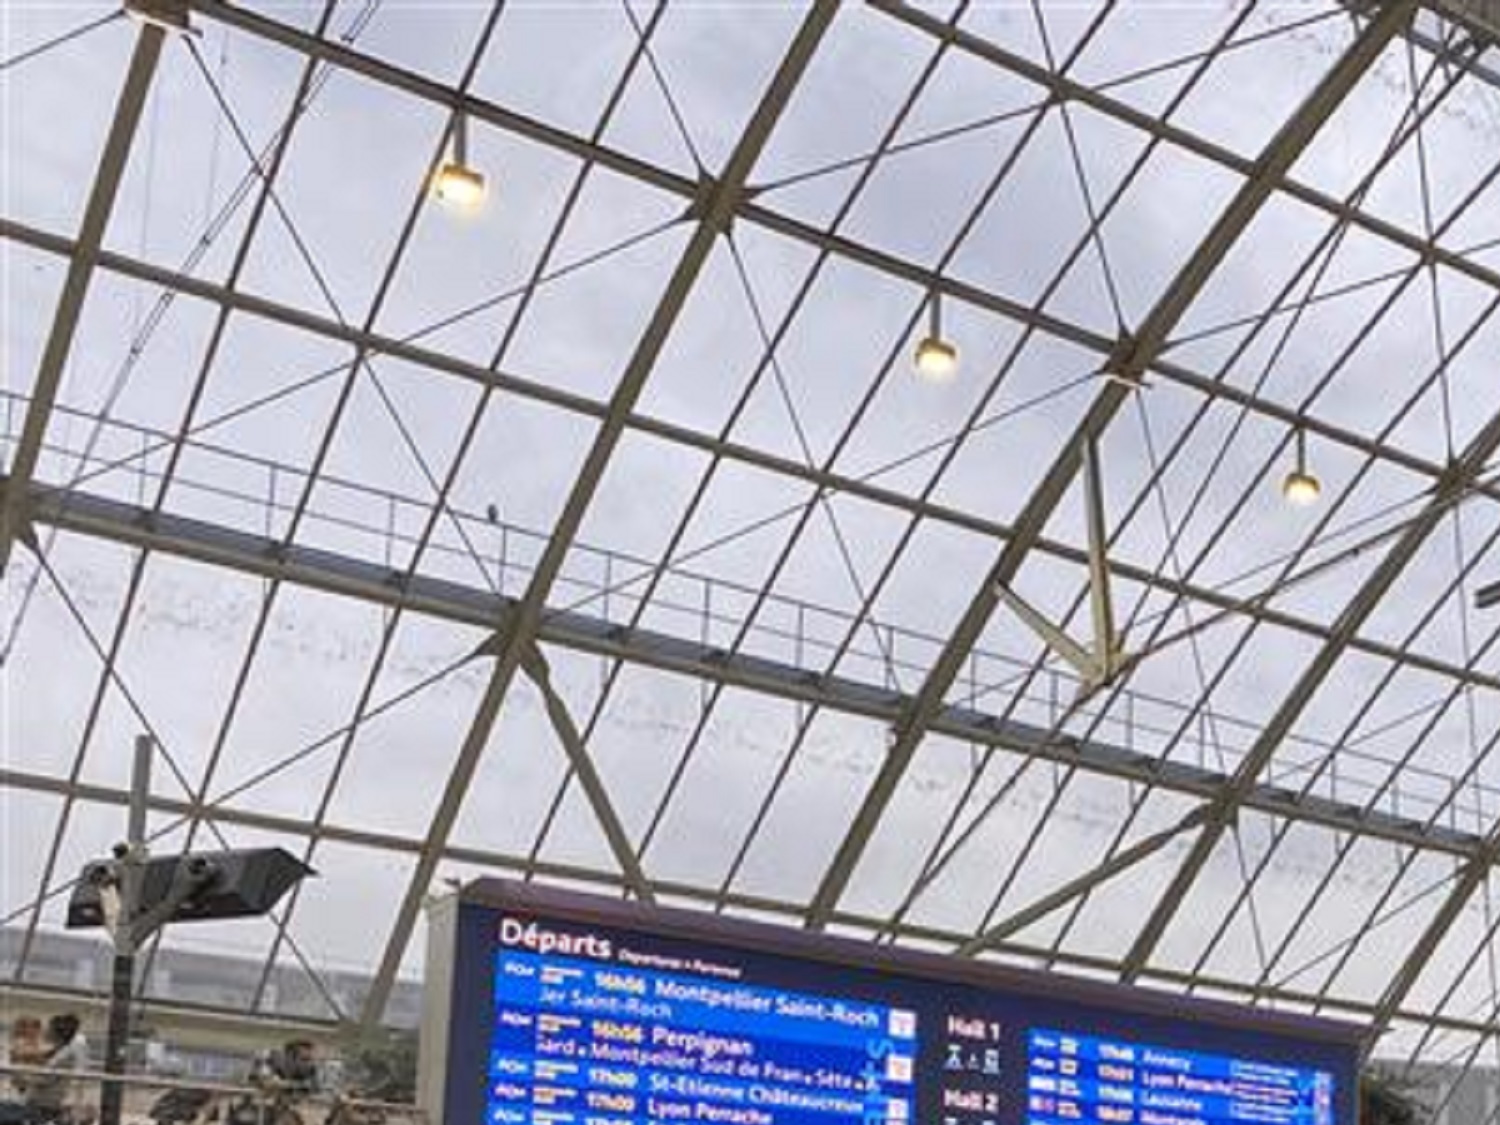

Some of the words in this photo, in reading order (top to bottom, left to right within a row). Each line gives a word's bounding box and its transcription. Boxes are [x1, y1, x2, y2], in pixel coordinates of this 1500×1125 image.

[501, 919, 612, 958] Départs
[655, 979, 771, 1013] Montpellier
[776, 994, 879, 1029] Saint-Roch
[652, 1026, 754, 1060] Perpignan
[947, 1015, 987, 1040] Hall
[990, 1021, 1000, 1042] 1
[647, 1096, 691, 1121] Lyon
[944, 1088, 984, 1112] Hall
[985, 1092, 998, 1113] 2
